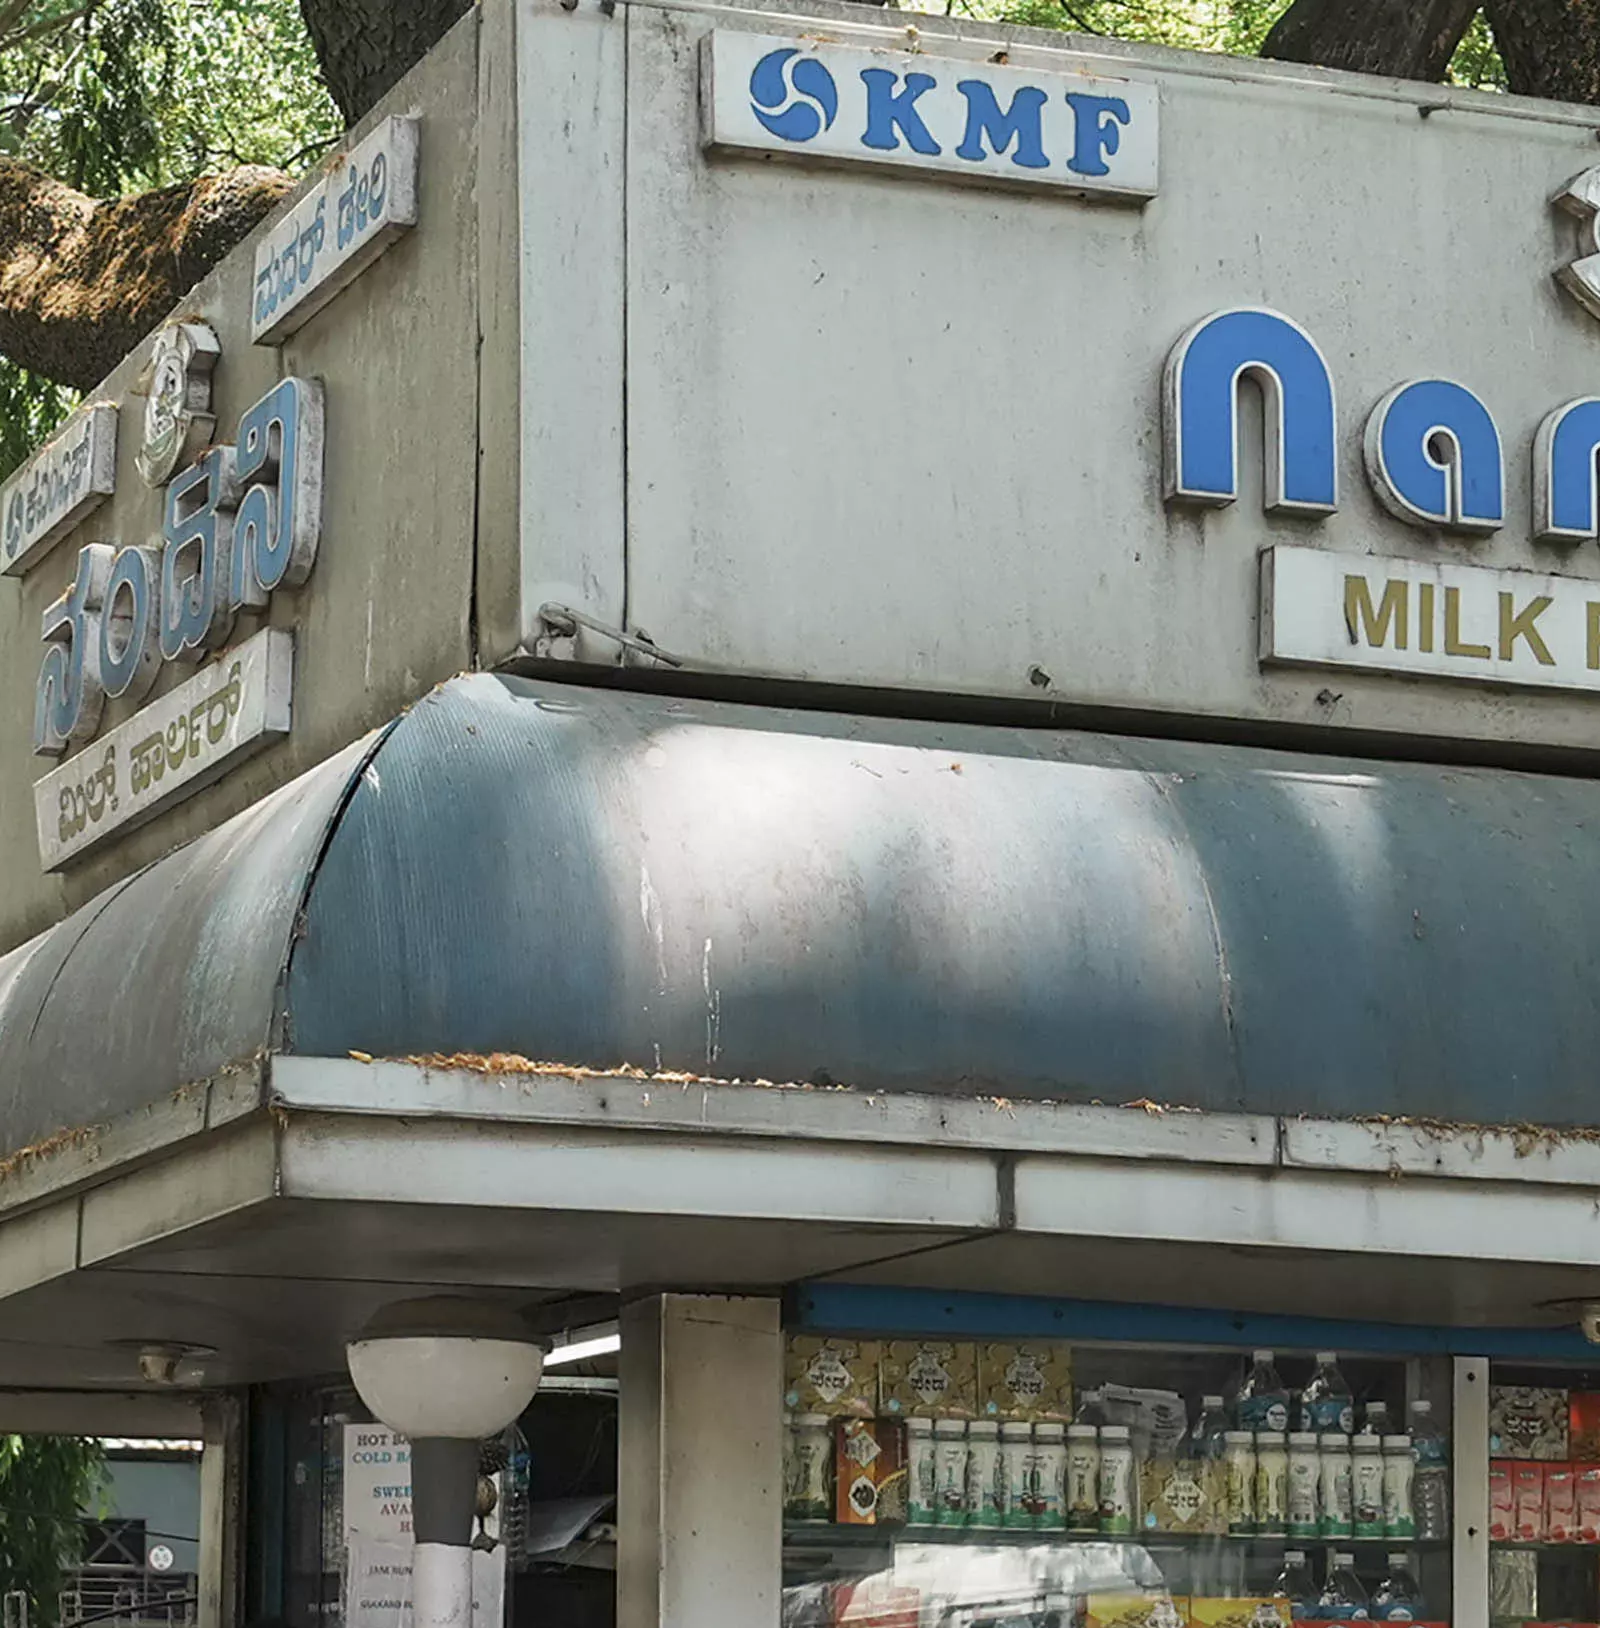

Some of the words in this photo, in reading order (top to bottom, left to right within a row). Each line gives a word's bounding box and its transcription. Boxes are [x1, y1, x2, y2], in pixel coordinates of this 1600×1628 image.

[858, 68, 1132, 177] KMF
[34, 377, 304, 754] ನಂದಿನಿ
[1344, 576, 1555, 665] MILK
[352, 1451, 392, 1464] COLD
[357, 1434, 387, 1446] HOT
